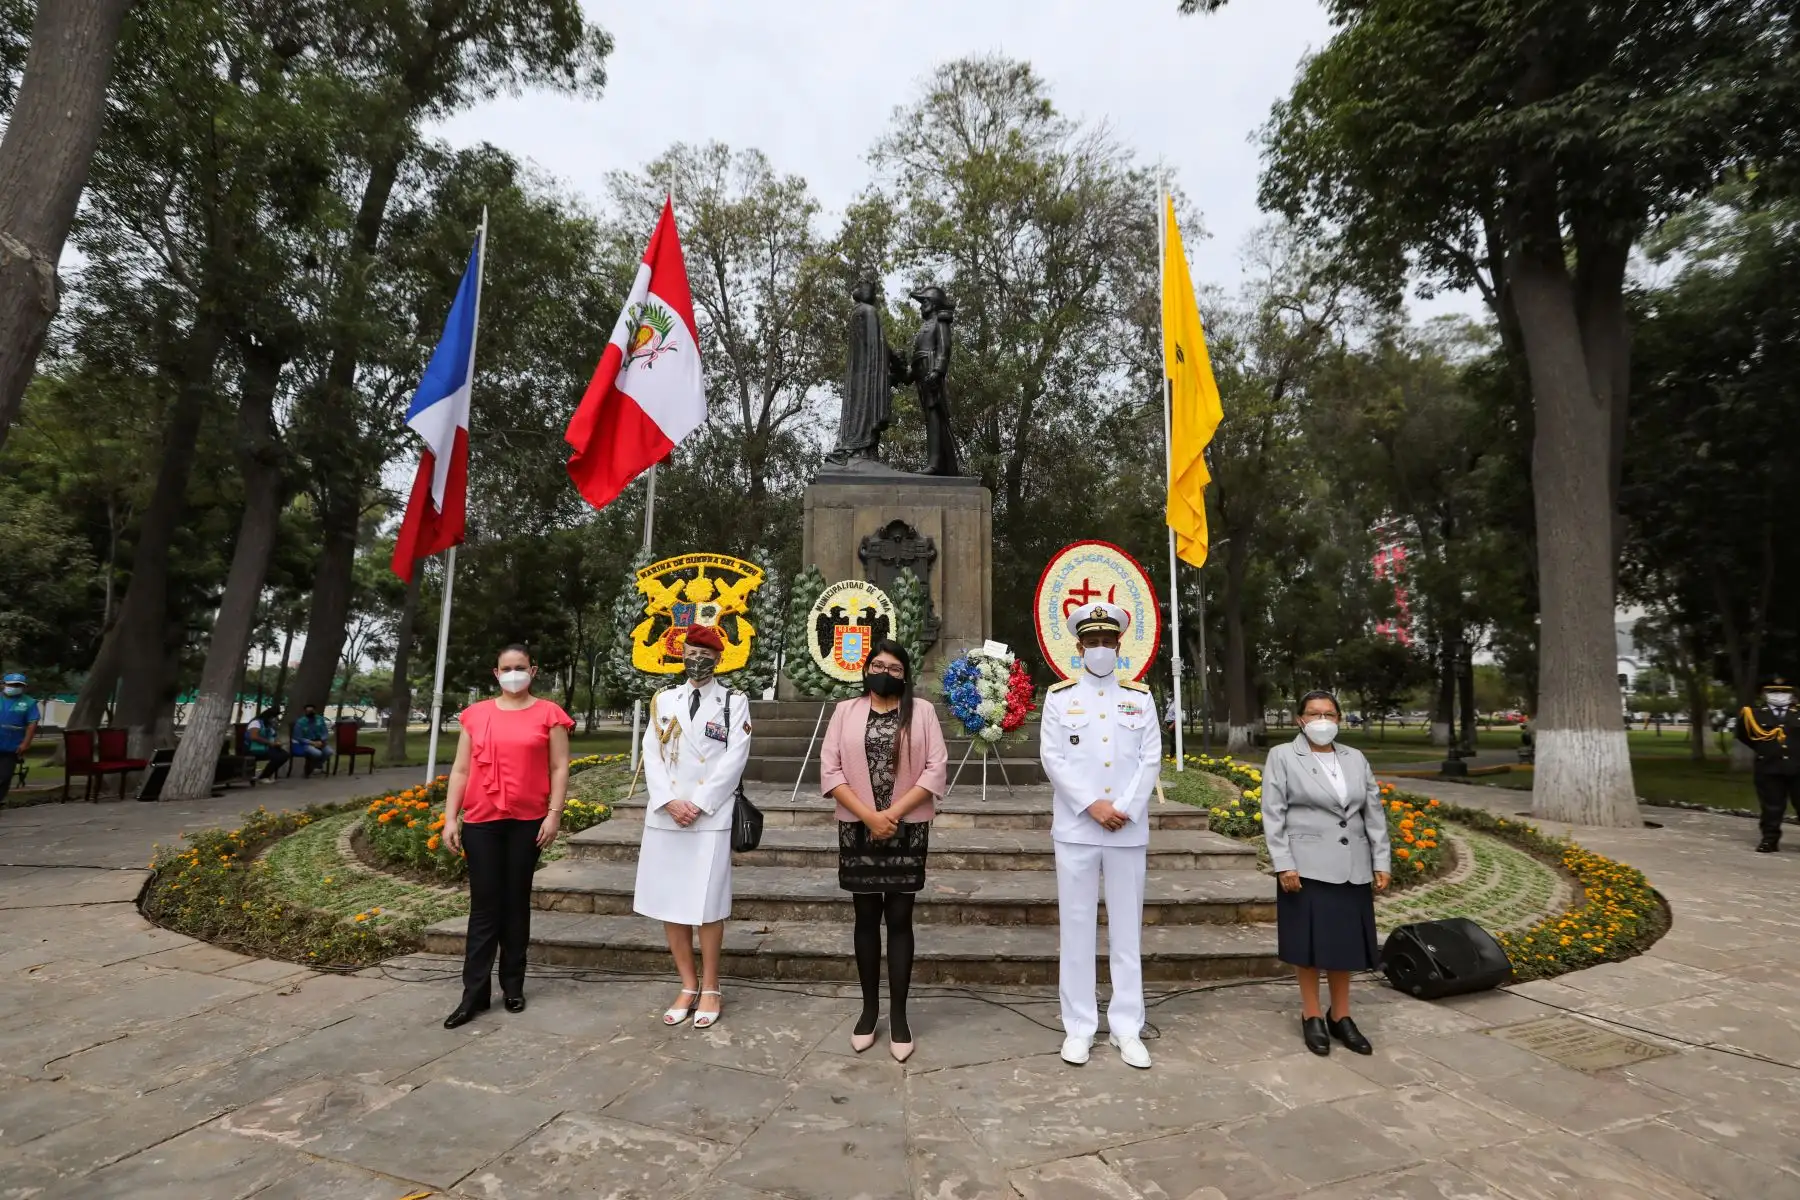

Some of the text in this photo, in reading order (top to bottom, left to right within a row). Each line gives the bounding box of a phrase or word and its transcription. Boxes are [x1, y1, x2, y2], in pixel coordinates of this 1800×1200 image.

[640, 562, 671, 579] MARINA
[673, 558, 684, 568] DE
[720, 557, 735, 568] DEL
[815, 581, 891, 613] MUNICIPALIDAD DE LIMA
[1048, 553, 1144, 641] COLEGIO DE LOS SAGRADOS CORAZONES
